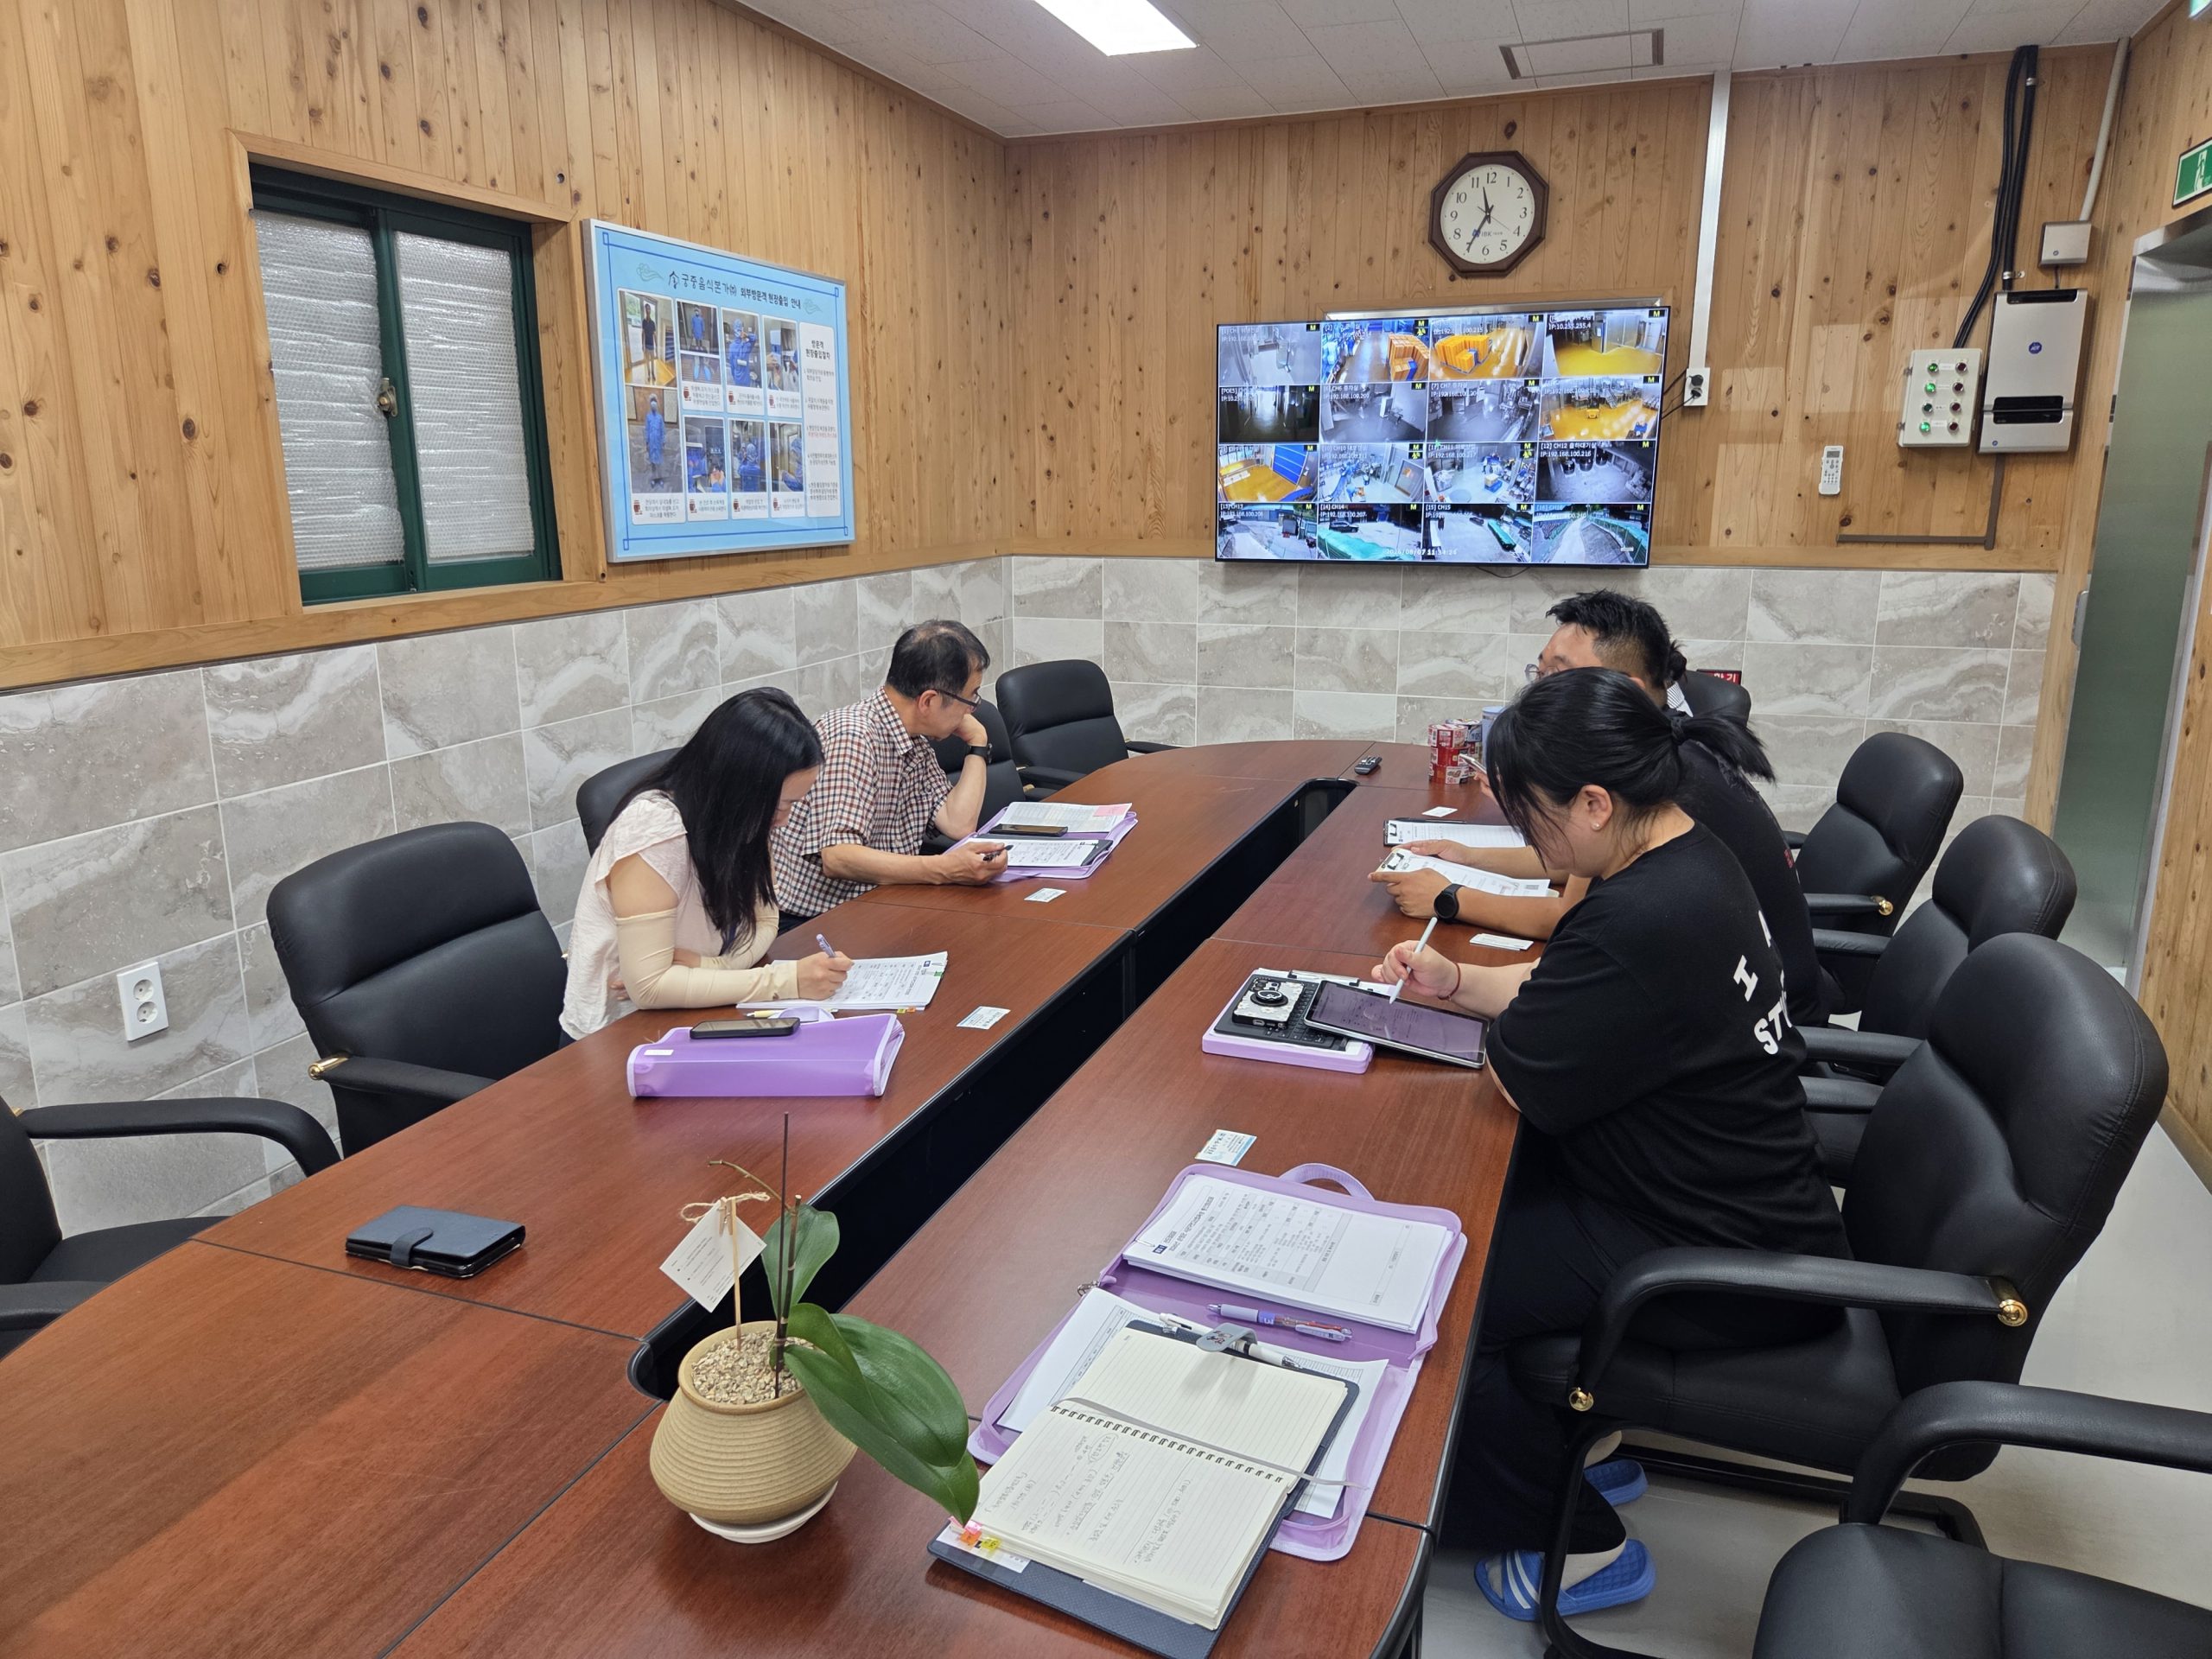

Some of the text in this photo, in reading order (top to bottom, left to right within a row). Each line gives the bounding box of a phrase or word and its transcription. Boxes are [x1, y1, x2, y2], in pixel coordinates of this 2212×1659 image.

[1471, 176, 1479, 188] 11
[1486, 172, 1497, 184] 12
[1506, 176, 1510, 187] 1
[1456, 192, 1467, 203] 10
[1516, 188, 1523, 199] 2
[1450, 211, 1458, 221] 9
[1519, 207, 1527, 219] 3
[1453, 228, 1461, 239] 8
[1513, 226, 1520, 237] 4
[1466, 242, 1472, 252] 7
[1482, 245, 1490, 256] 6
[1499, 239, 1507, 251] 5
[791, 298, 801, 309] 안내
